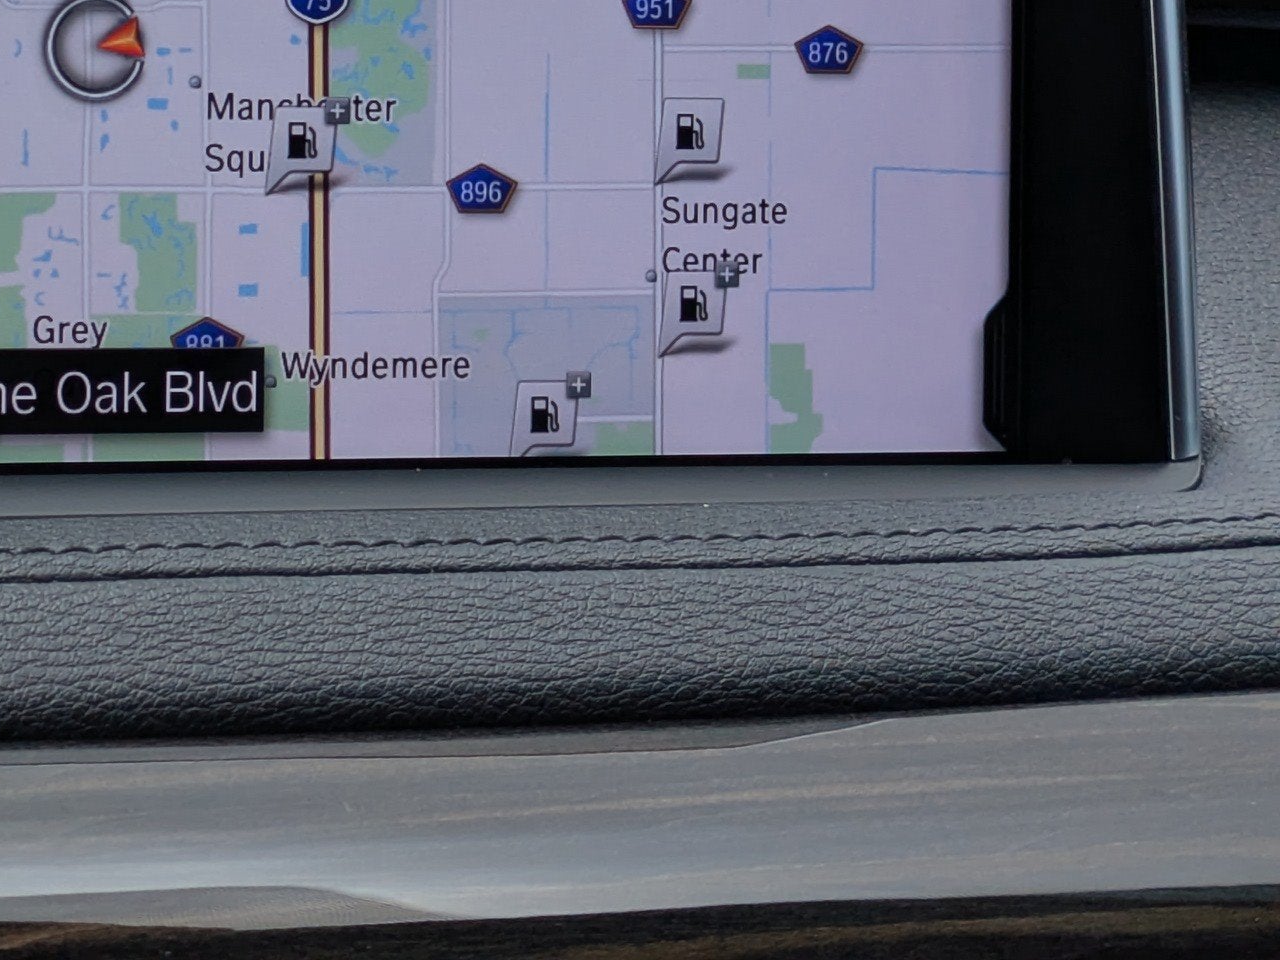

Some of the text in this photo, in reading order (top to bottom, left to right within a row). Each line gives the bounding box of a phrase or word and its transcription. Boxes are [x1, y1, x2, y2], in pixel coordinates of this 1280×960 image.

[808, 43, 849, 65] 876
[207, 92, 397, 122] Manter
[460, 182, 502, 204] 896
[662, 196, 788, 230] Sungate
[662, 246, 763, 275] Center
[33, 315, 108, 350] Grey
[282, 351, 471, 386] Wyndemere
[56, 371, 148, 415] Oak
[166, 369, 258, 414] Blvd
